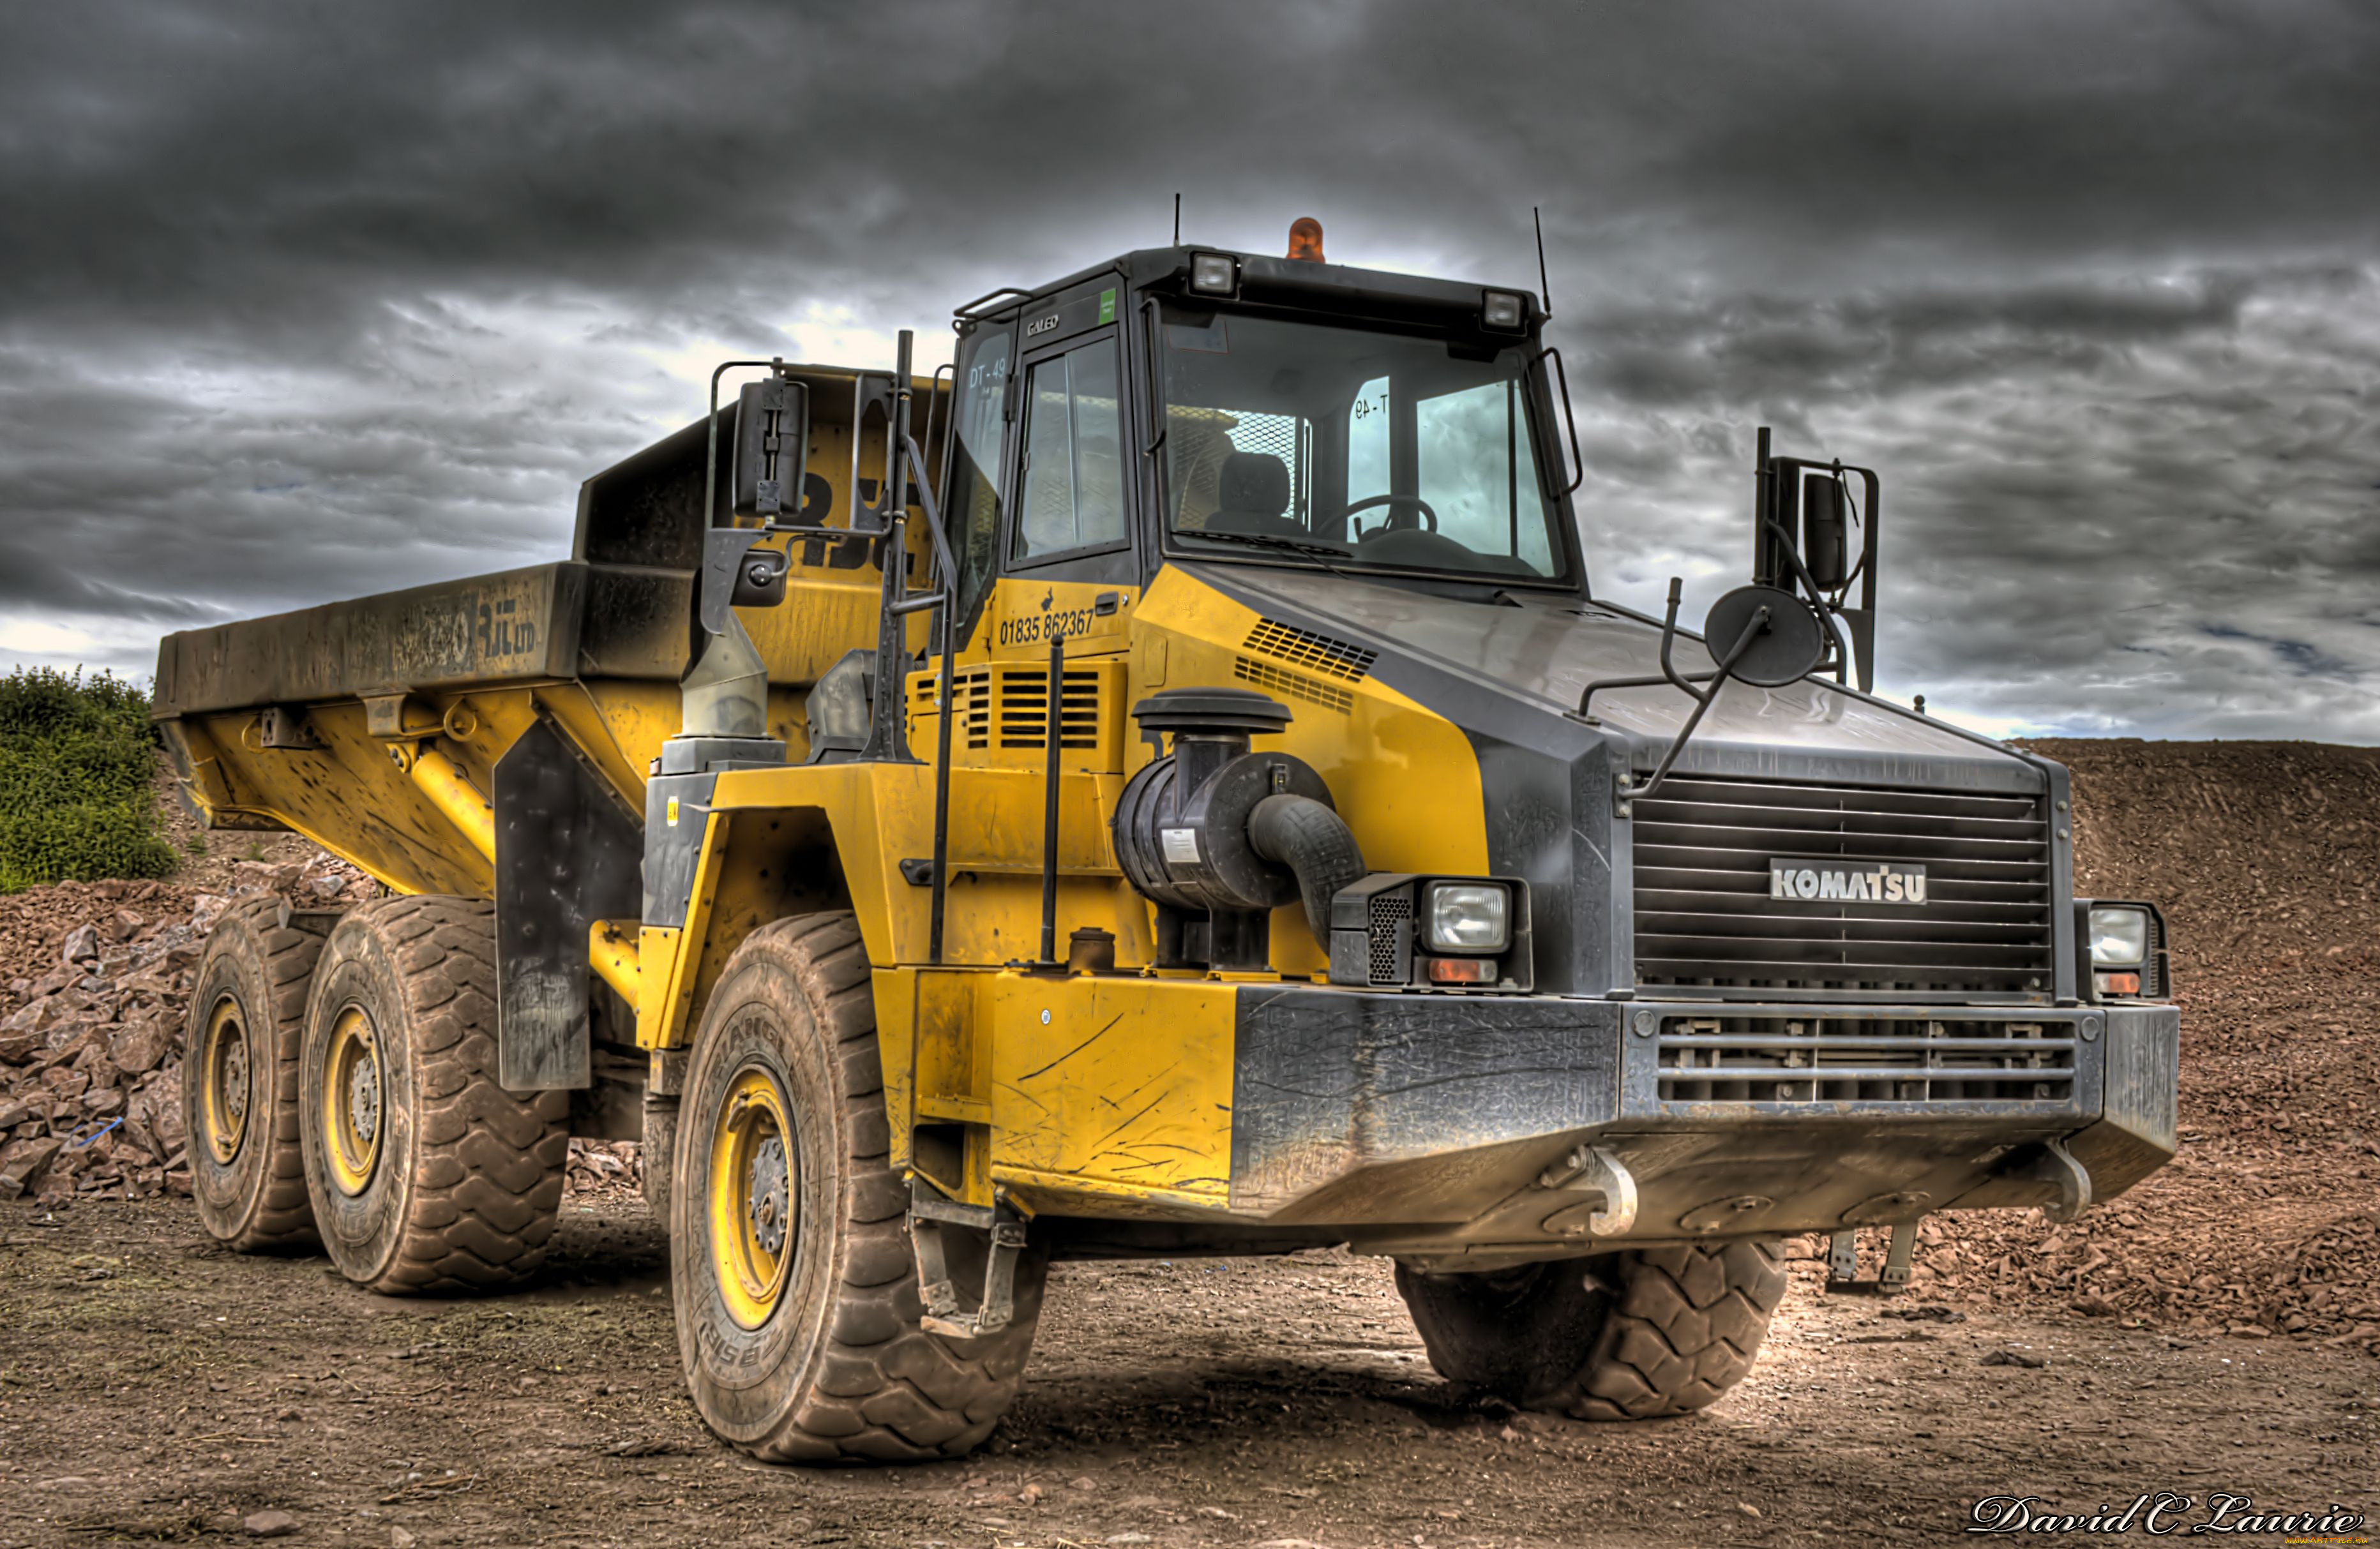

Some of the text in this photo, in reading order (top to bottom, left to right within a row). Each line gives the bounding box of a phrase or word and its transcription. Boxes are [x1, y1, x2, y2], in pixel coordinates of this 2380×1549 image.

[1027, 314, 1059, 337] GALEO
[1000, 608, 1094, 645] 01835 862367
[1772, 864, 1925, 902] KOMATSU
